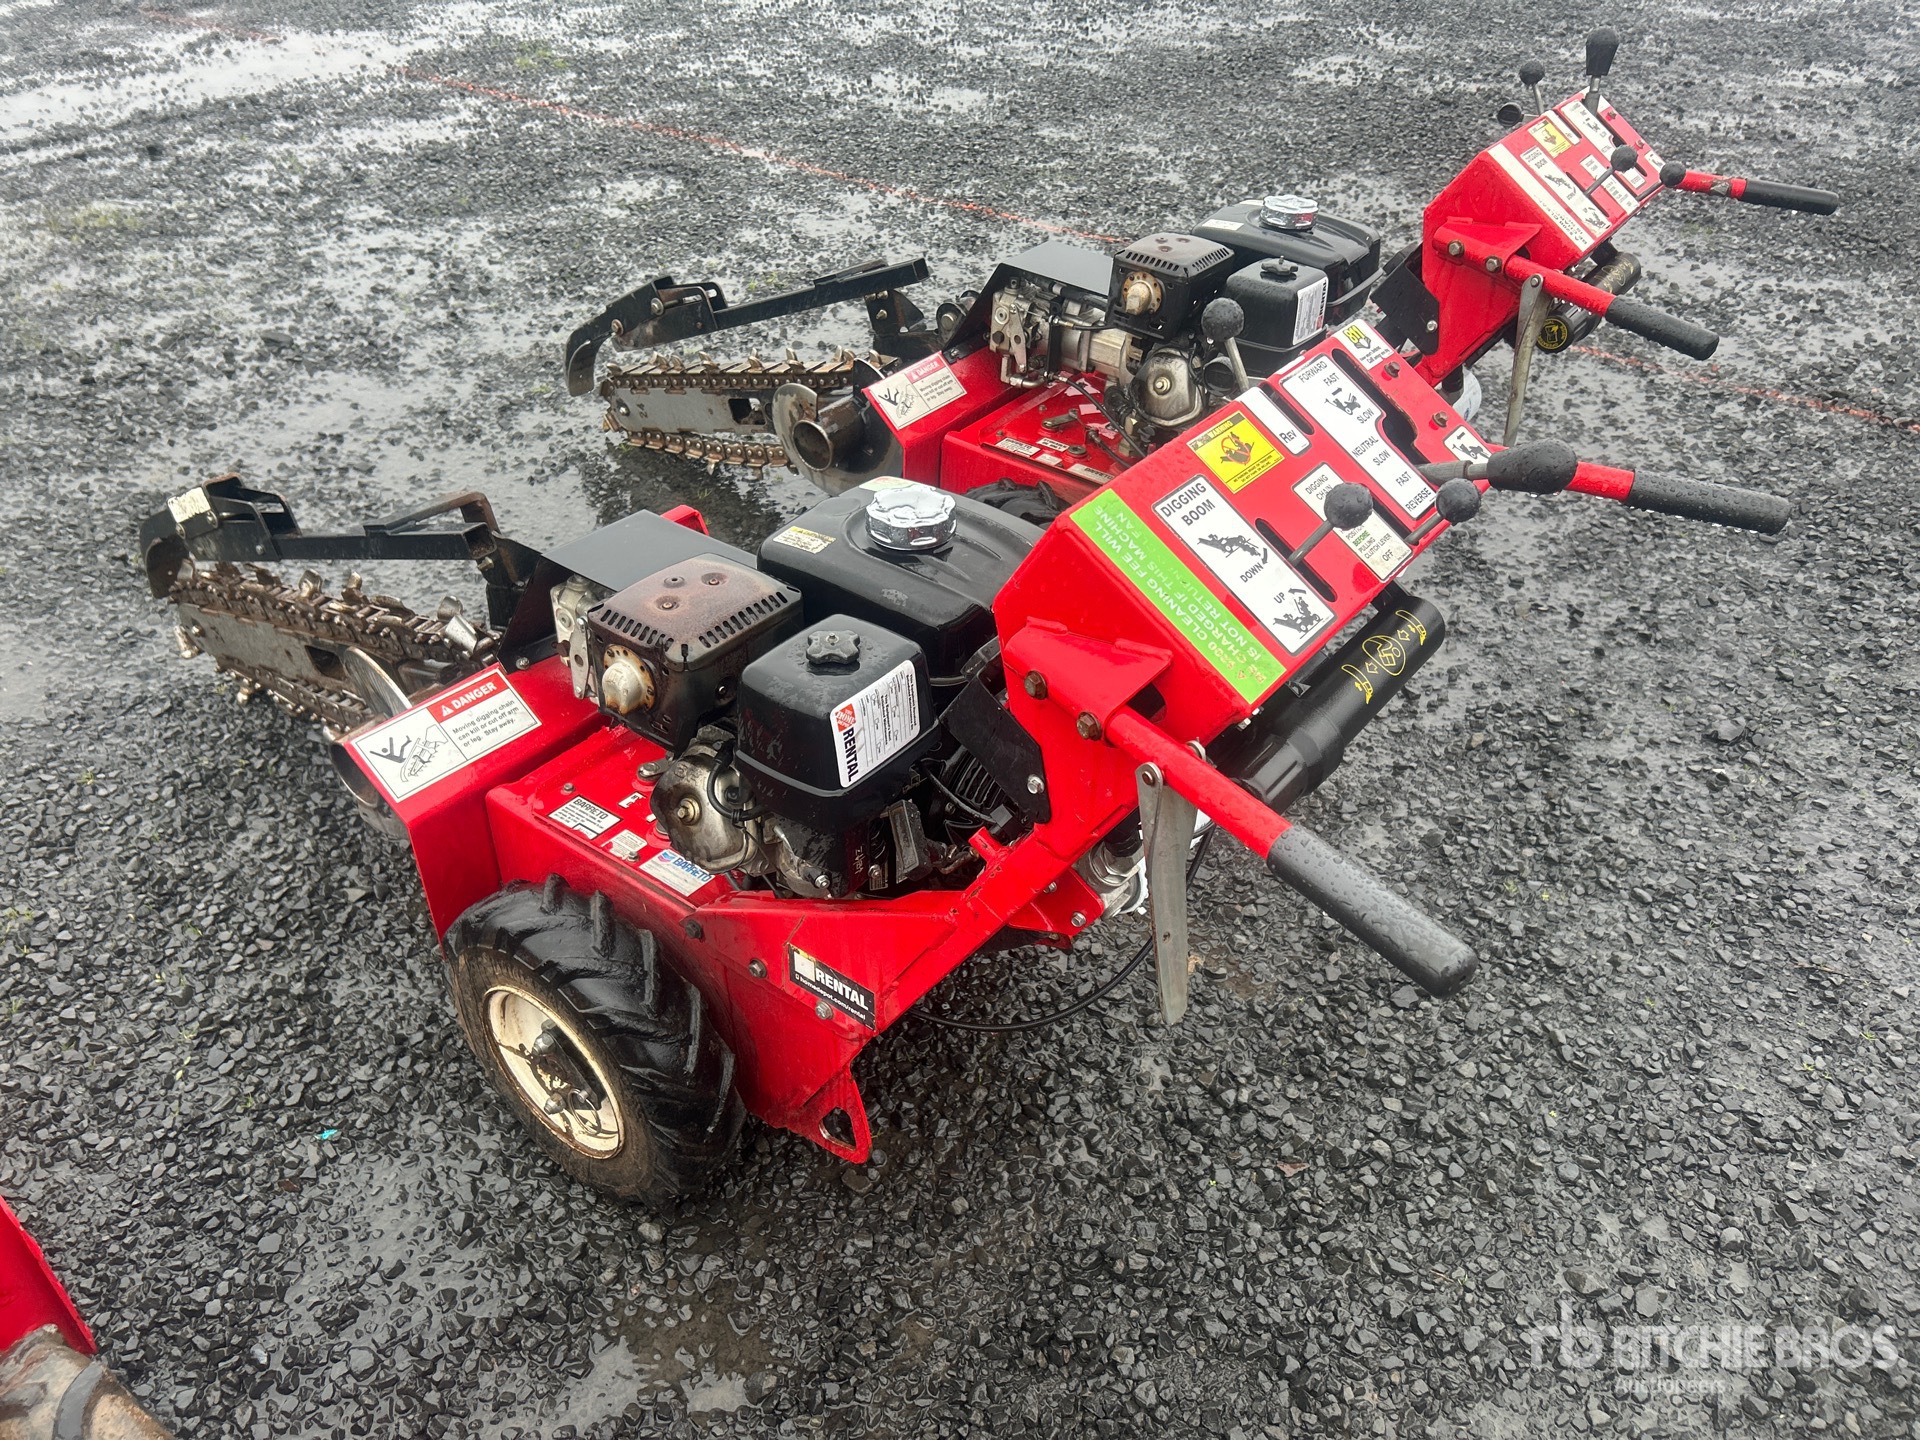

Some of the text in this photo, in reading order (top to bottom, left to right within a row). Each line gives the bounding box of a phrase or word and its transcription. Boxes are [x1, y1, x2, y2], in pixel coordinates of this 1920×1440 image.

[916, 361, 940, 376] DANGER
[1299, 360, 1328, 384] FORWARD
[1323, 372, 1340, 387] FAST
[1358, 408, 1374, 424] SLOW
[1352, 436, 1378, 458] NEUTRAL
[1373, 450, 1390, 466] SLOW
[1305, 474, 1329, 496] DIGGING
[1396, 471, 1412, 486] FAST
[1161, 482, 1207, 518] DIGGING
[1406, 488, 1432, 512] REVERSE
[1181, 499, 1216, 526] BOOM
[1091, 520, 1124, 553] WILL
[1352, 530, 1371, 548] BEFORE
[1358, 537, 1376, 553] PULLING
[1364, 542, 1380, 559] CLUTCH
[1377, 533, 1392, 548] LEVER
[1121, 551, 1148, 578] FEE
[1382, 548, 1394, 562] OFF
[1240, 562, 1263, 583] DOWN
[1092, 504, 1267, 684] BE CHARGED IF THIS MACHINE
[1273, 592, 1286, 605] UP
[1145, 576, 1209, 641] CLEANING
[1219, 617, 1248, 647] NOT
[1246, 645, 1261, 661] IS
[451, 681, 497, 710] DANGER
[452, 699, 515, 733] Moving digging chain
[483, 726, 499, 736] Stay
[498, 717, 516, 729] away.
[457, 732, 470, 740] can
[469, 726, 480, 734] kill
[843, 727, 859, 782] RENTAL
[572, 796, 608, 821] BARRETO
[672, 855, 711, 884] BARRETO
[816, 968, 868, 1010] RENTAL
